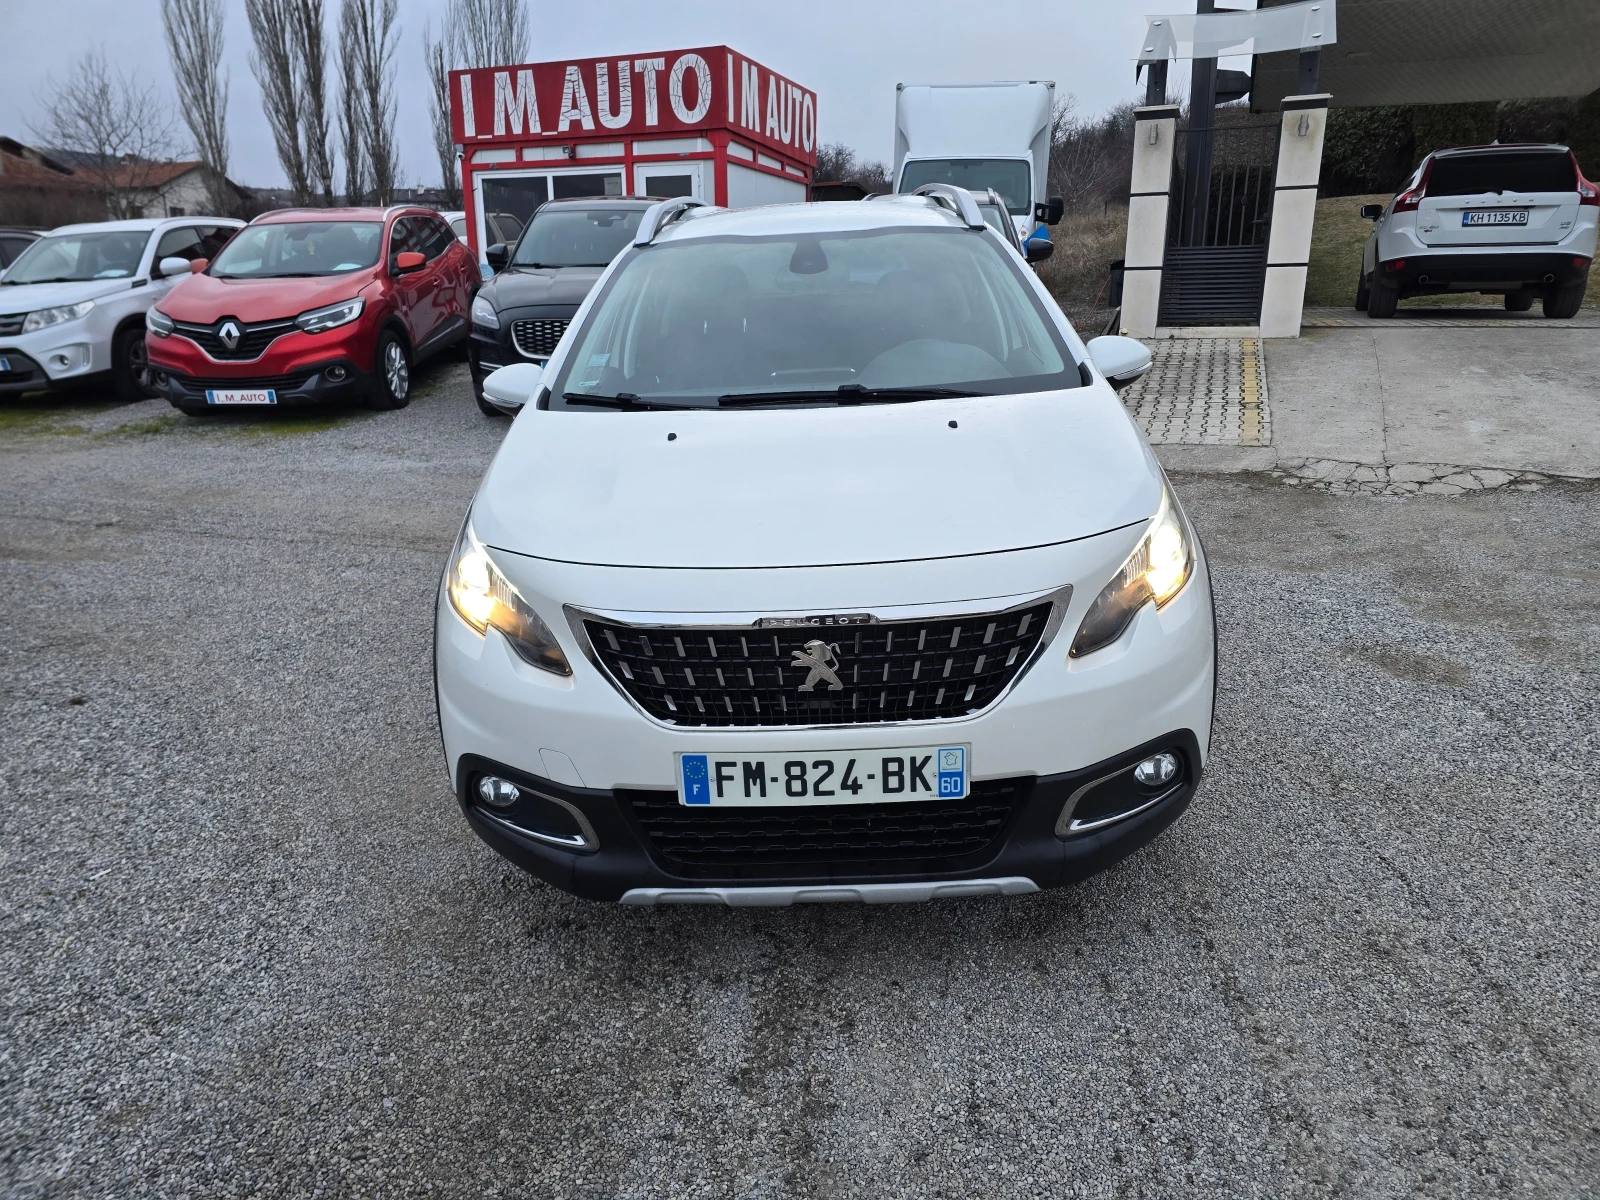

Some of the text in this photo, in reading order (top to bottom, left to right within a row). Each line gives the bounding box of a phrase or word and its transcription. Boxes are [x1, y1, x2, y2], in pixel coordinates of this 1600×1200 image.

[726, 53, 814, 153] I M AUTO
[1470, 212, 1526, 223] KH 1135 KB
[715, 755, 932, 798] FM-824-BK
[693, 784, 701, 795] F
[941, 777, 961, 793] 60
